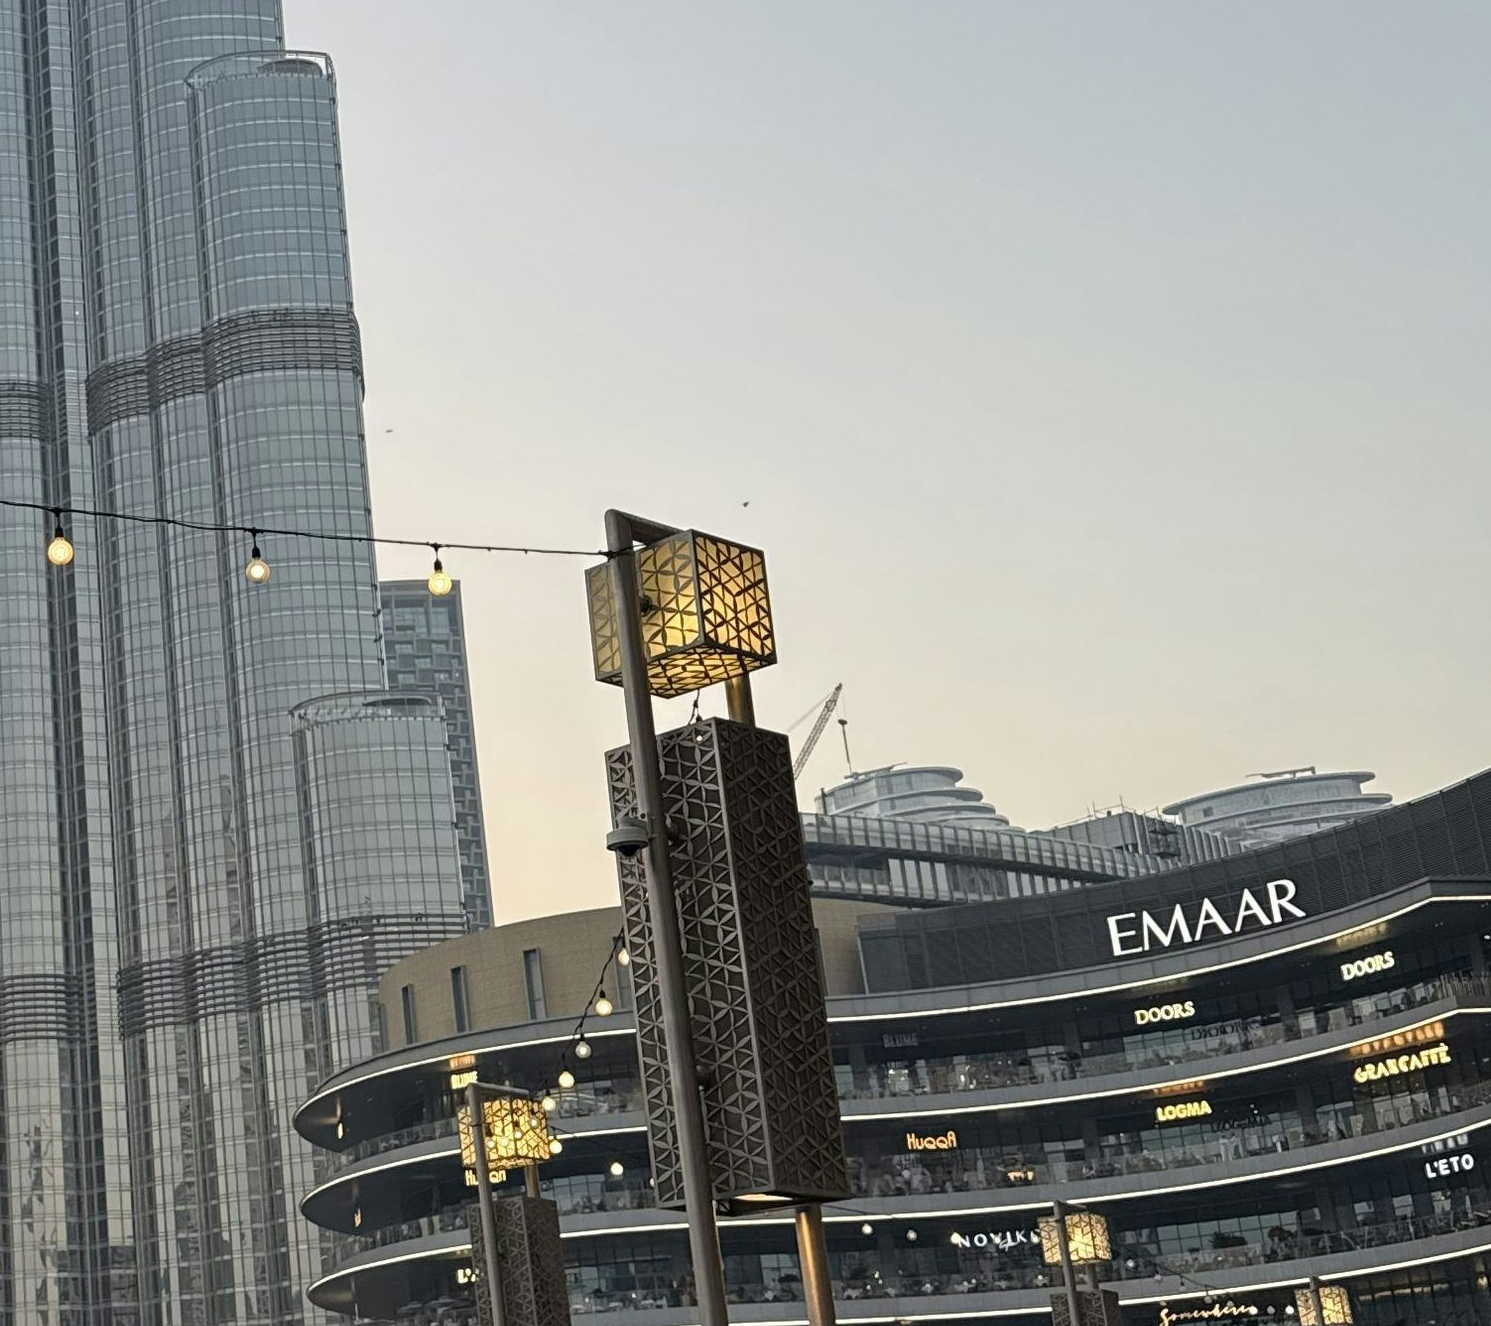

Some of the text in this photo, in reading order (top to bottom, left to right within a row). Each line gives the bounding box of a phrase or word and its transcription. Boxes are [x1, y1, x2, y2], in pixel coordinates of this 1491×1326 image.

[1107, 878, 1307, 957] EMAAR
[1341, 950, 1396, 981] DOORS
[1134, 1001, 1196, 1025] DOORS
[1156, 1100, 1213, 1122] LOGMA
[1424, 1153, 1475, 1179] L'ETO
